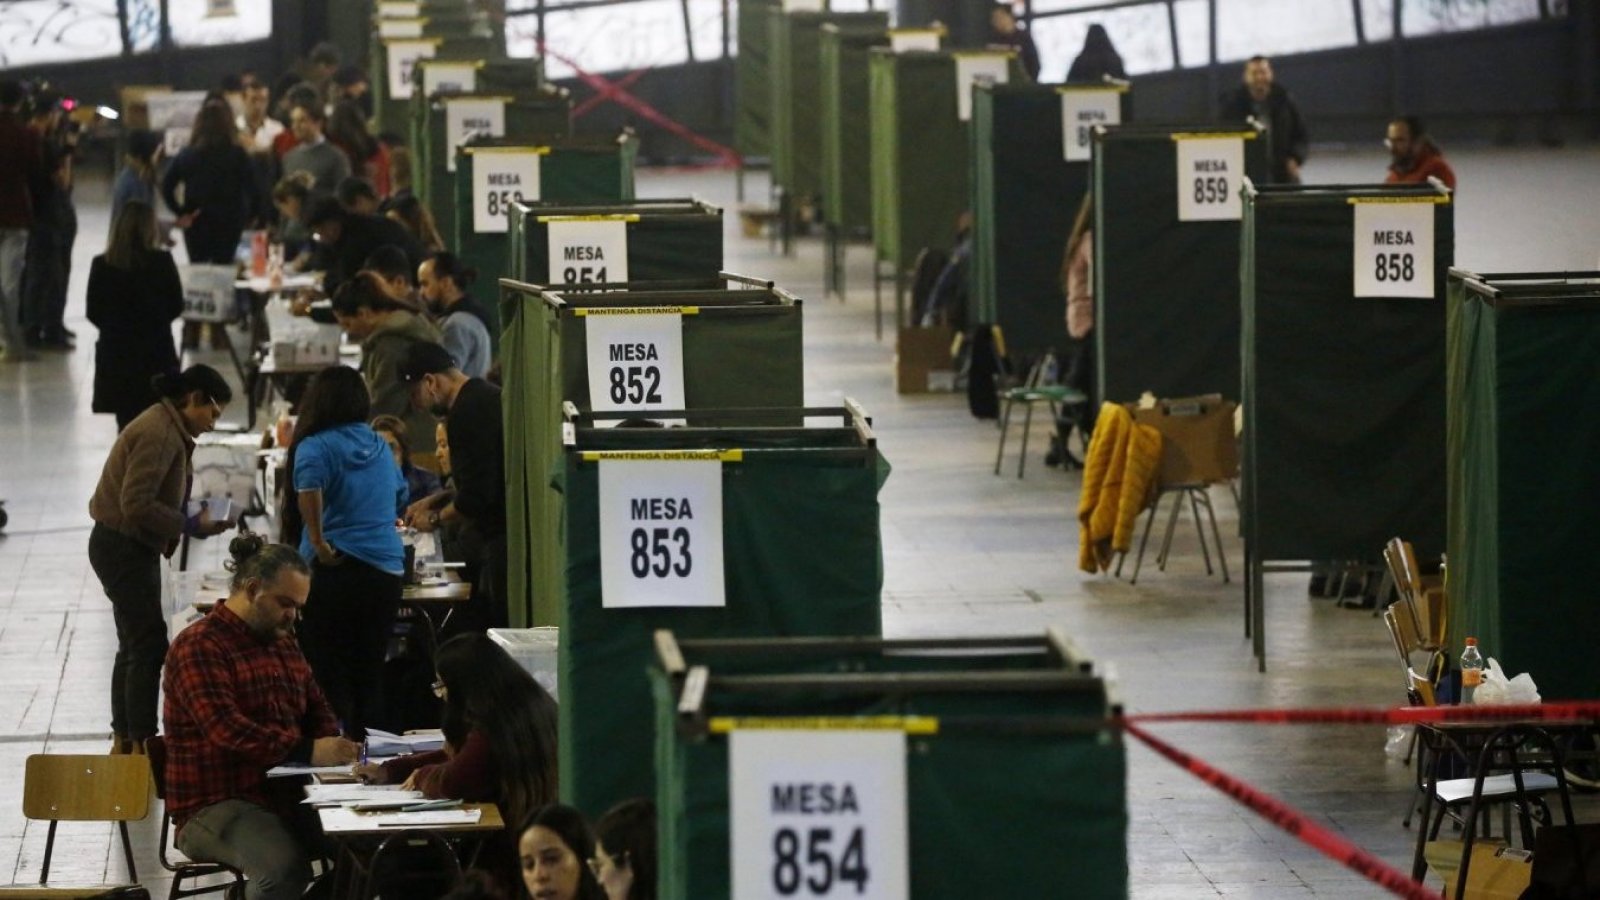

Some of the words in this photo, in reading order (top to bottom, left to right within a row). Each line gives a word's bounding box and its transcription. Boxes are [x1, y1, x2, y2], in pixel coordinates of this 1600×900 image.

[1194, 159, 1227, 171] MESA
[487, 173, 521, 186] MESA
[1194, 176, 1228, 204] 859
[1373, 231, 1415, 246] MESA
[564, 246, 604, 261] MESA
[1375, 253, 1415, 282] 858
[609, 343, 658, 362] MESA
[610, 366, 662, 404] 852
[600, 452, 660, 461] MANTENGA
[664, 451, 720, 461] DISTANCIA
[631, 498, 693, 520] MESA
[631, 527, 693, 579] 853
[771, 782, 860, 815] MESA
[772, 825, 870, 896] 854
